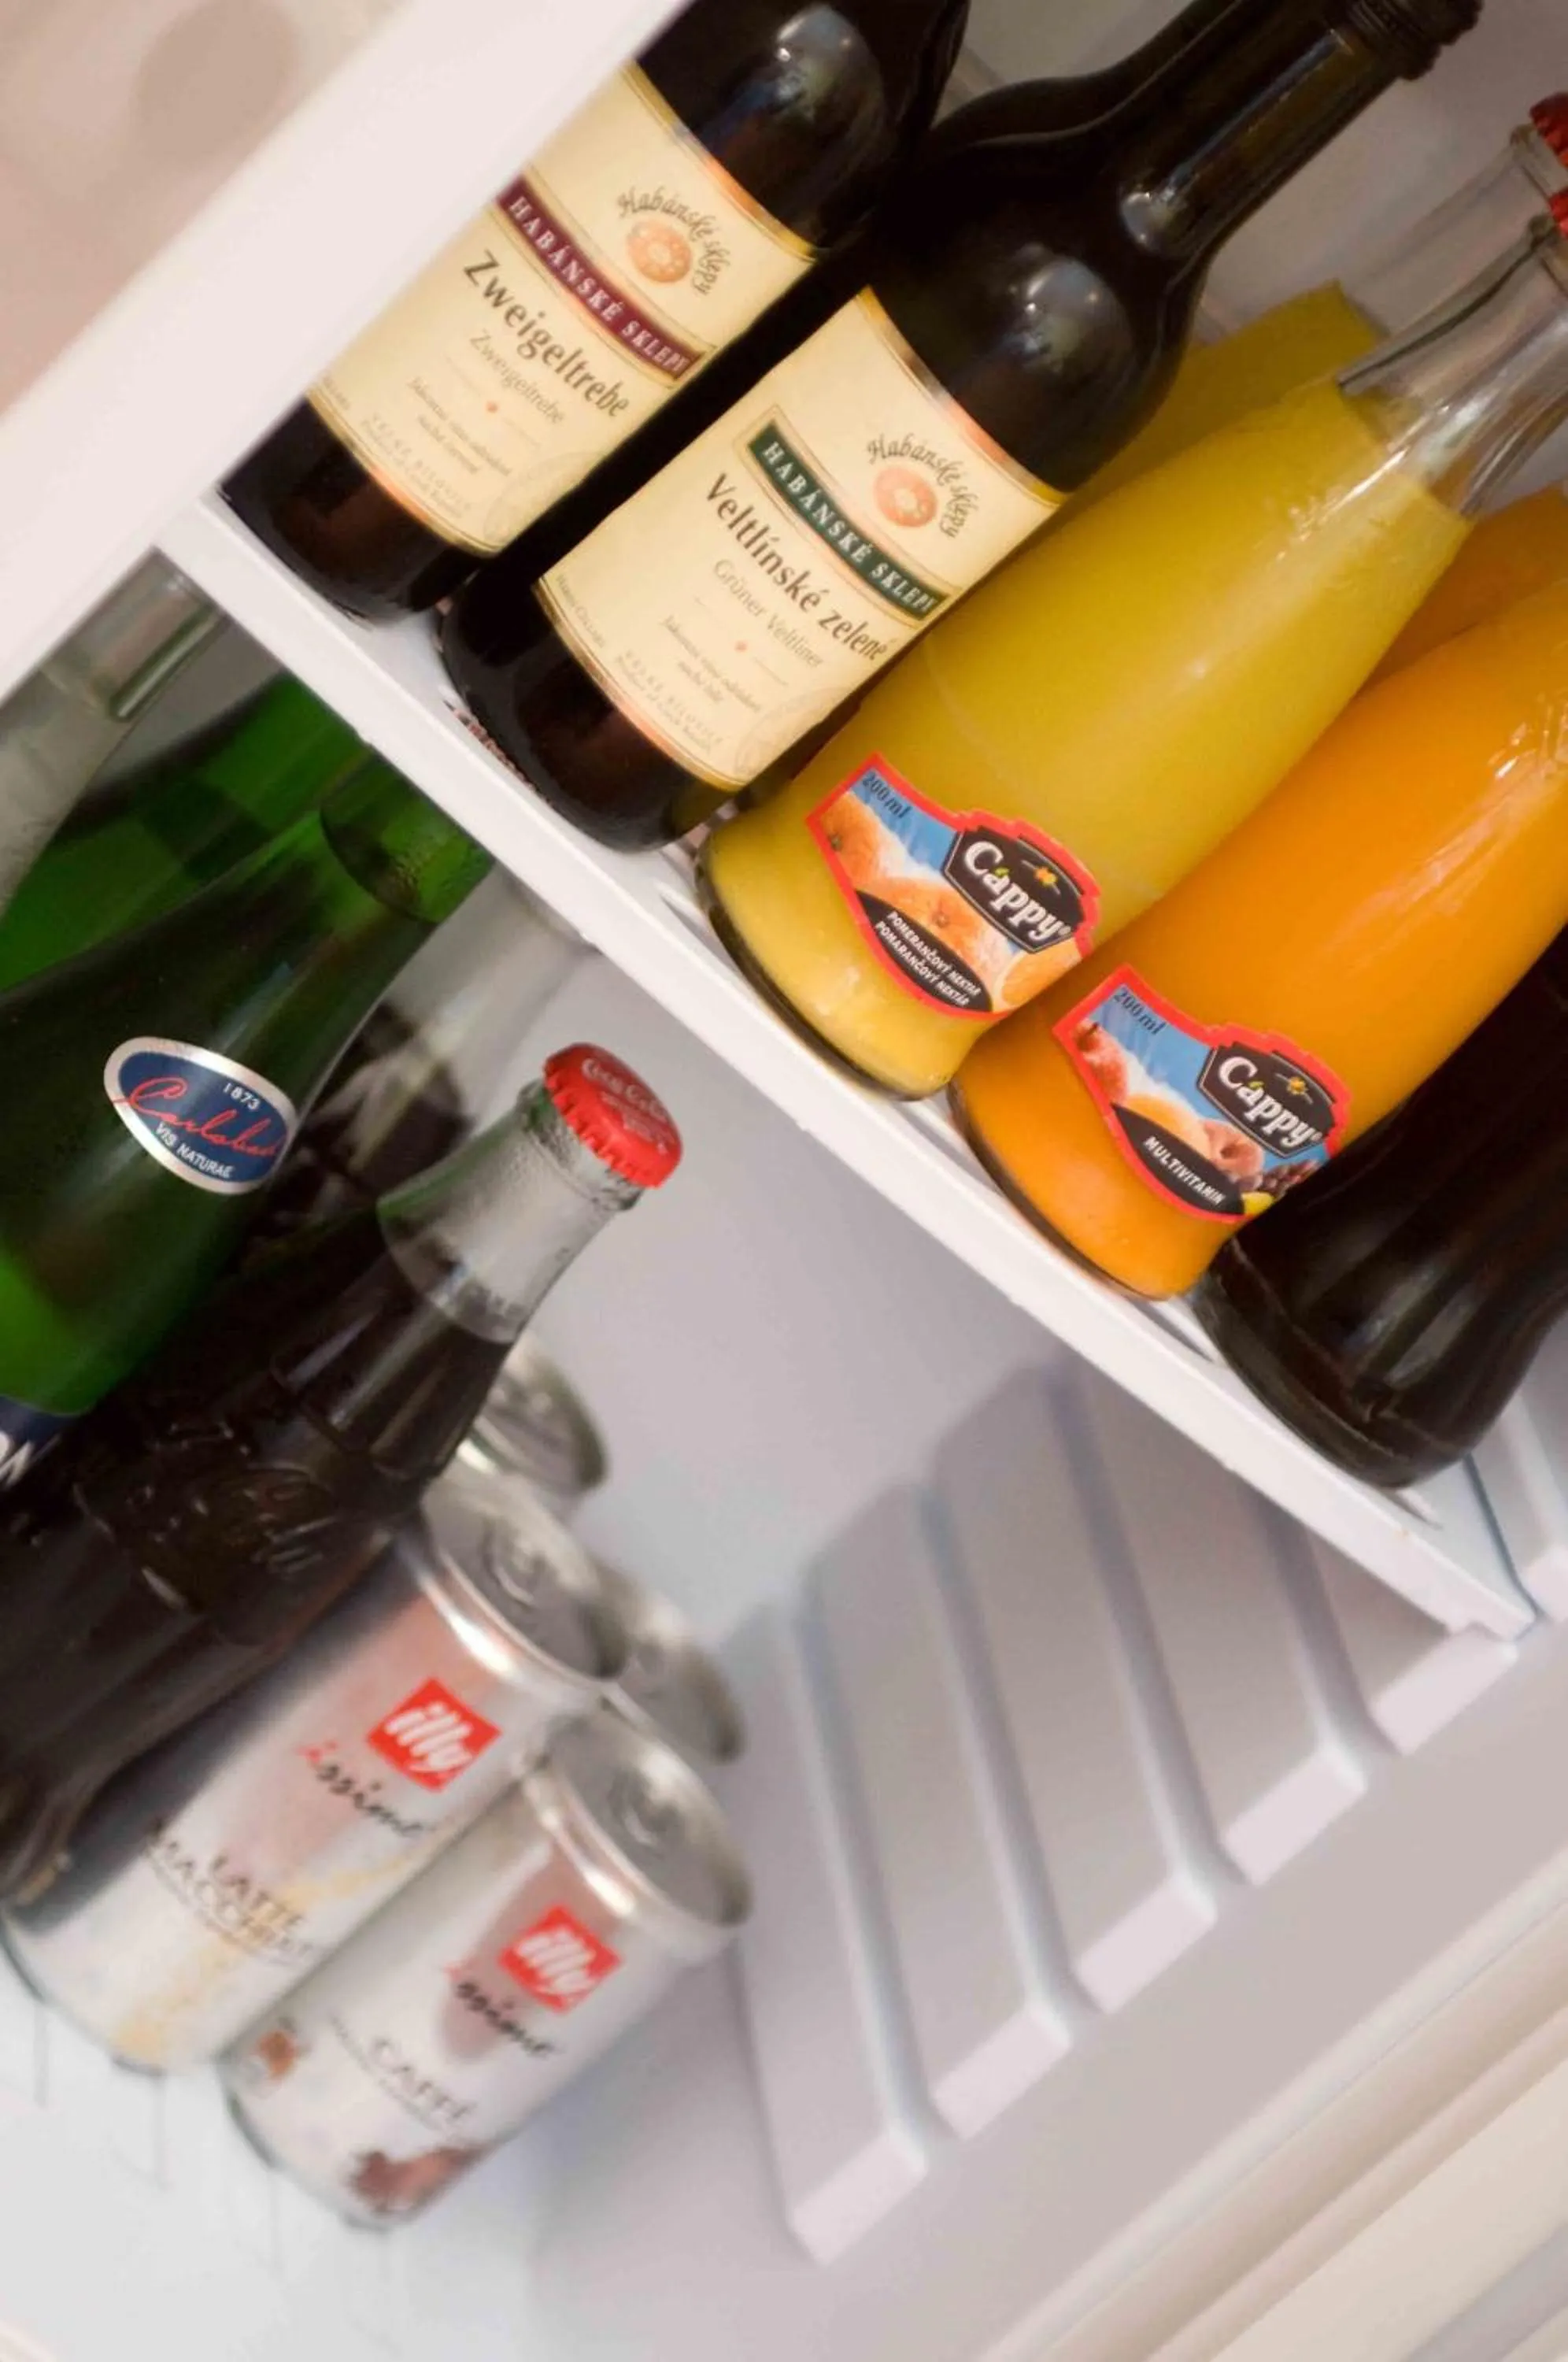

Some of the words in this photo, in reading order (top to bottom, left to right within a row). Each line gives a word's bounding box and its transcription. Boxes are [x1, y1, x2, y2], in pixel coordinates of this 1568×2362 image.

[509, 196, 624, 321] HABÁNSKÉ
[463, 249, 630, 416] Zweigeltrebe
[762, 441, 875, 563] HABÁNSKÉ
[707, 473, 830, 613] Veltlínské
[819, 609, 898, 661] zelené
[713, 559, 767, 618] Grüner
[767, 613, 824, 668] Veltliner
[224, 1083, 261, 1109] 1873
[156, 1122, 179, 1146] VIS
[176, 1142, 234, 1179] NATURAE
[1143, 1135, 1226, 1206] MULTIVITAMIN
[385, 1701, 474, 1773] illy
[516, 1925, 598, 1996] illy
